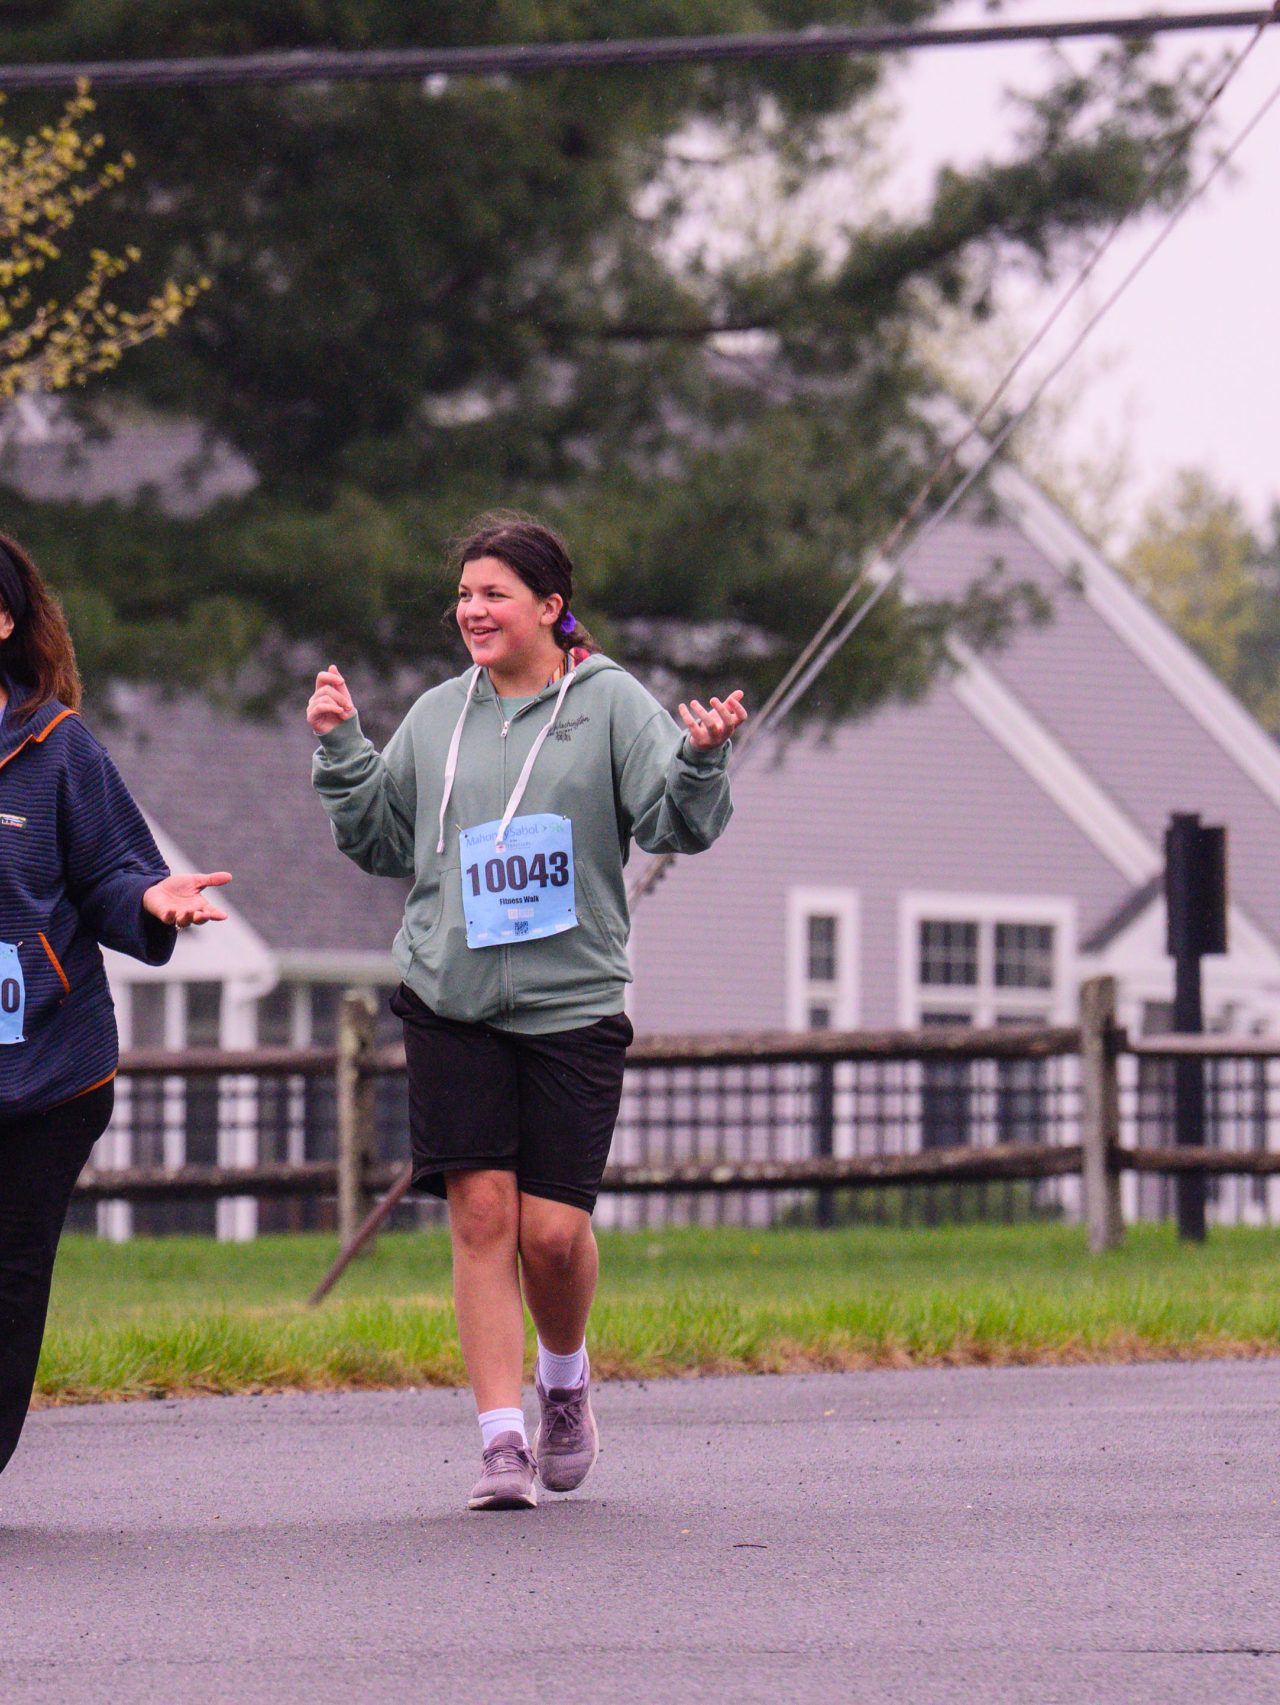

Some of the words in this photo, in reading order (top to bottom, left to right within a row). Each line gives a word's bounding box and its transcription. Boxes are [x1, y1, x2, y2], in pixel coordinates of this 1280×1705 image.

[466, 824, 539, 847] MahonySabol
[466, 851, 569, 897] 10043
[499, 896, 523, 905] Fitness
[523, 895, 540, 904] Walk
